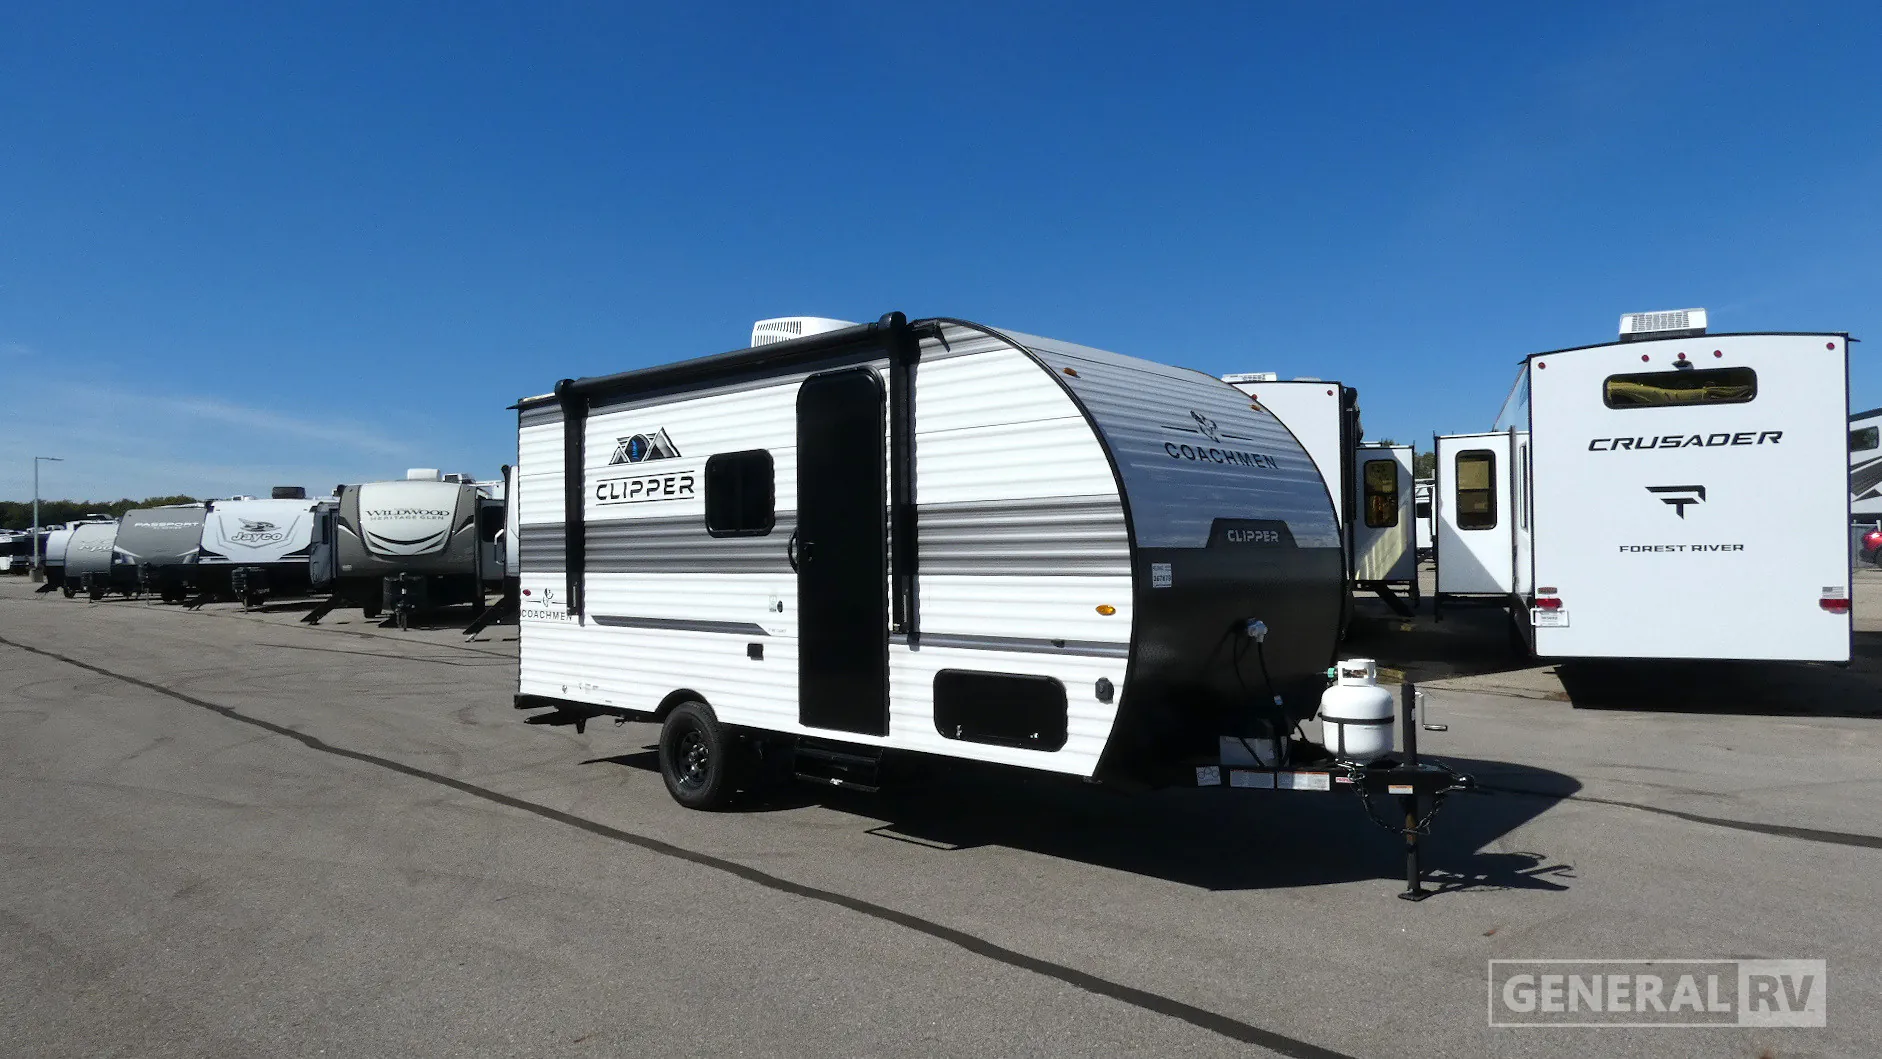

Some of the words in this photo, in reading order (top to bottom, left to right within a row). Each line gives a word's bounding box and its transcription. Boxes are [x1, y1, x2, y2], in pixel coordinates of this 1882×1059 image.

[1588, 430, 1783, 452] CRUSADER
[1164, 442, 1279, 470] COACHMEN
[596, 475, 695, 501] CLIPPER
[366, 509, 450, 517] WILDWOOD
[231, 531, 283, 542] Jayco
[1227, 529, 1279, 543] CLIPPER
[1619, 544, 1687, 553] FOREST
[1691, 543, 1744, 552] RIVER
[521, 609, 572, 621] COACHMEN
